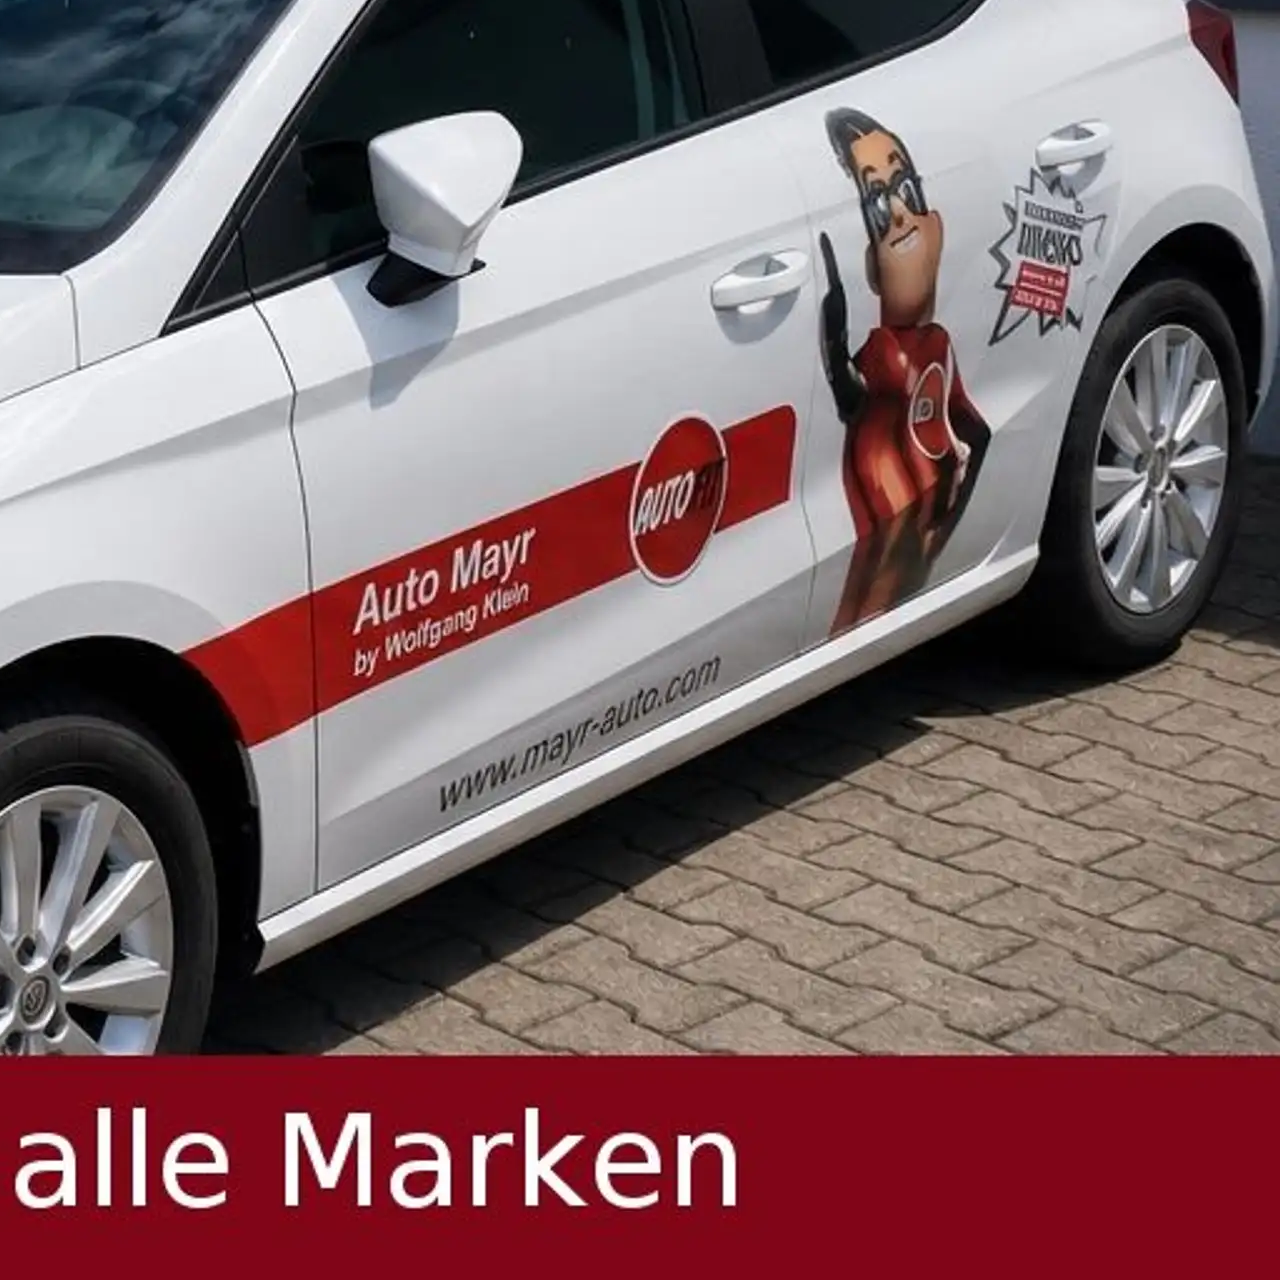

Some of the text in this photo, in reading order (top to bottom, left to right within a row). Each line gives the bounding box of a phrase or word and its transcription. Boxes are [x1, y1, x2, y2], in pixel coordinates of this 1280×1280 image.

[353, 527, 537, 636] Auto Mayr
[353, 581, 529, 677] by Wolfgang Klein
[439, 655, 722, 813] www.mayr-auto.com
